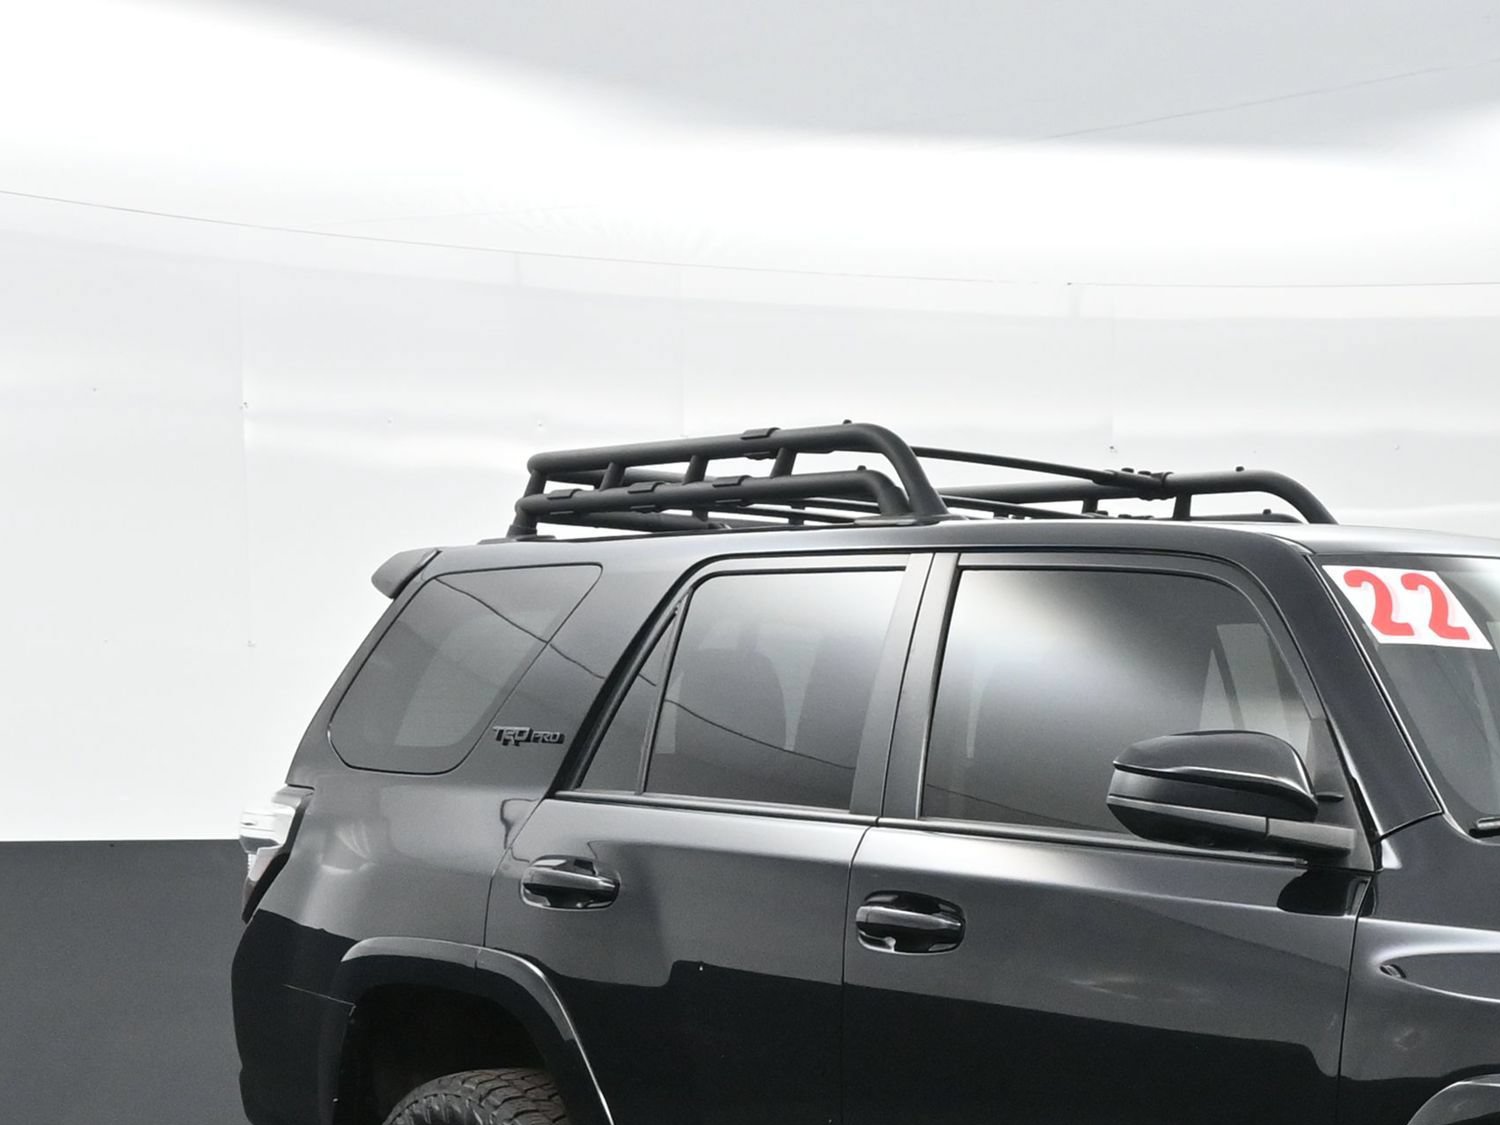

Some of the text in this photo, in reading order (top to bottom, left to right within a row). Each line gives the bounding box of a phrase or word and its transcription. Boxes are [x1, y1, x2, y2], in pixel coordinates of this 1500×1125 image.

[1343, 569, 1470, 640] 22
[492, 726, 564, 746] TRD PRO
